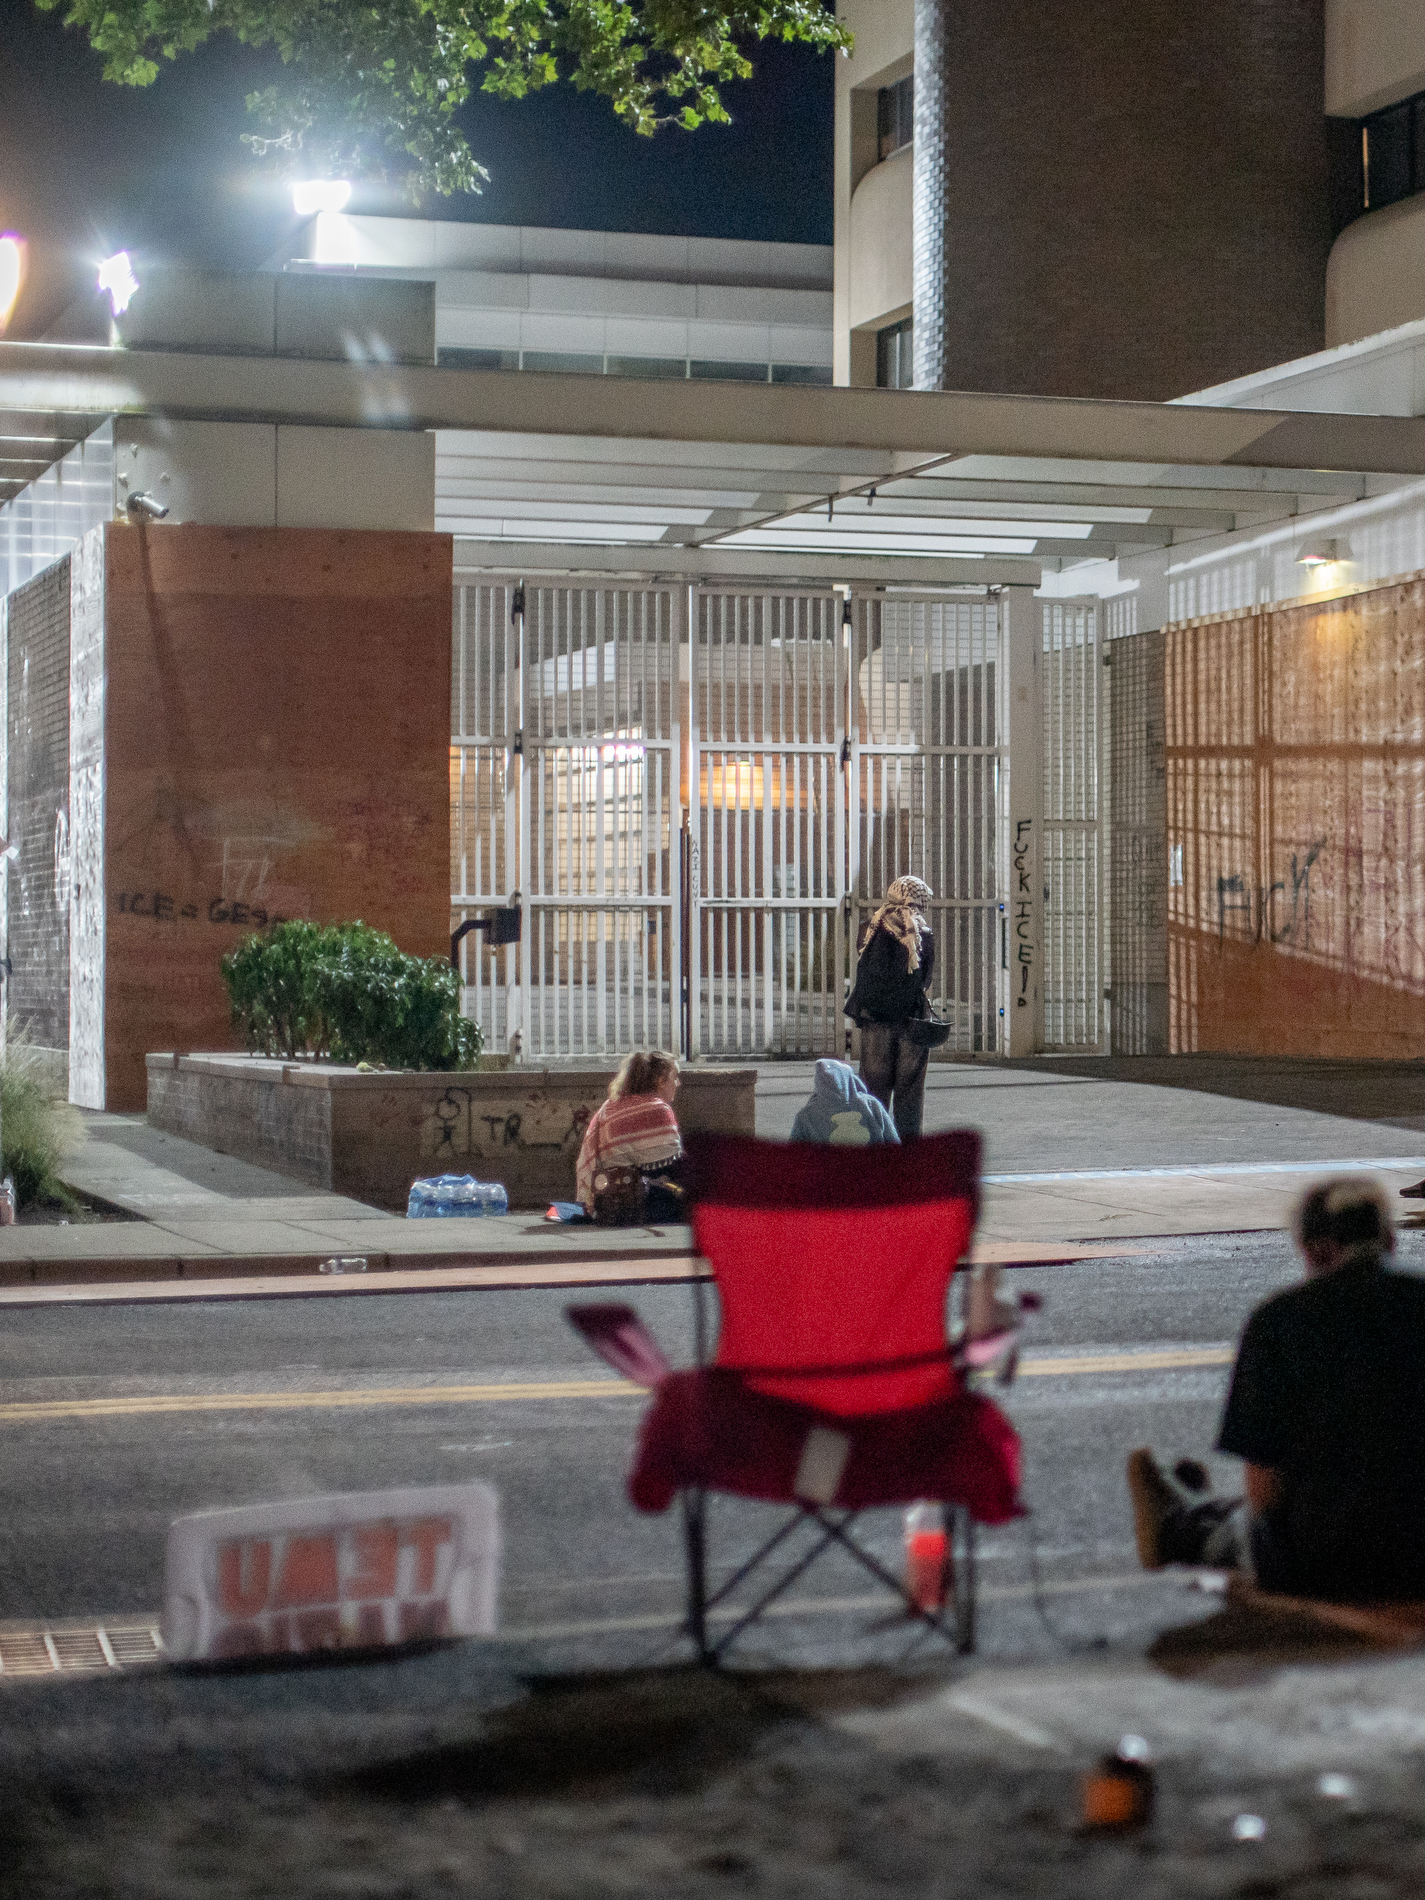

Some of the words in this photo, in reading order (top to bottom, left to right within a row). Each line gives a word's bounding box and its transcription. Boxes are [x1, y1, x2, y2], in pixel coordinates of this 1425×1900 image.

[1013, 818, 1032, 893] FUCK
[117, 892, 177, 921] ICE
[1015, 901, 1035, 1007] ICE!
